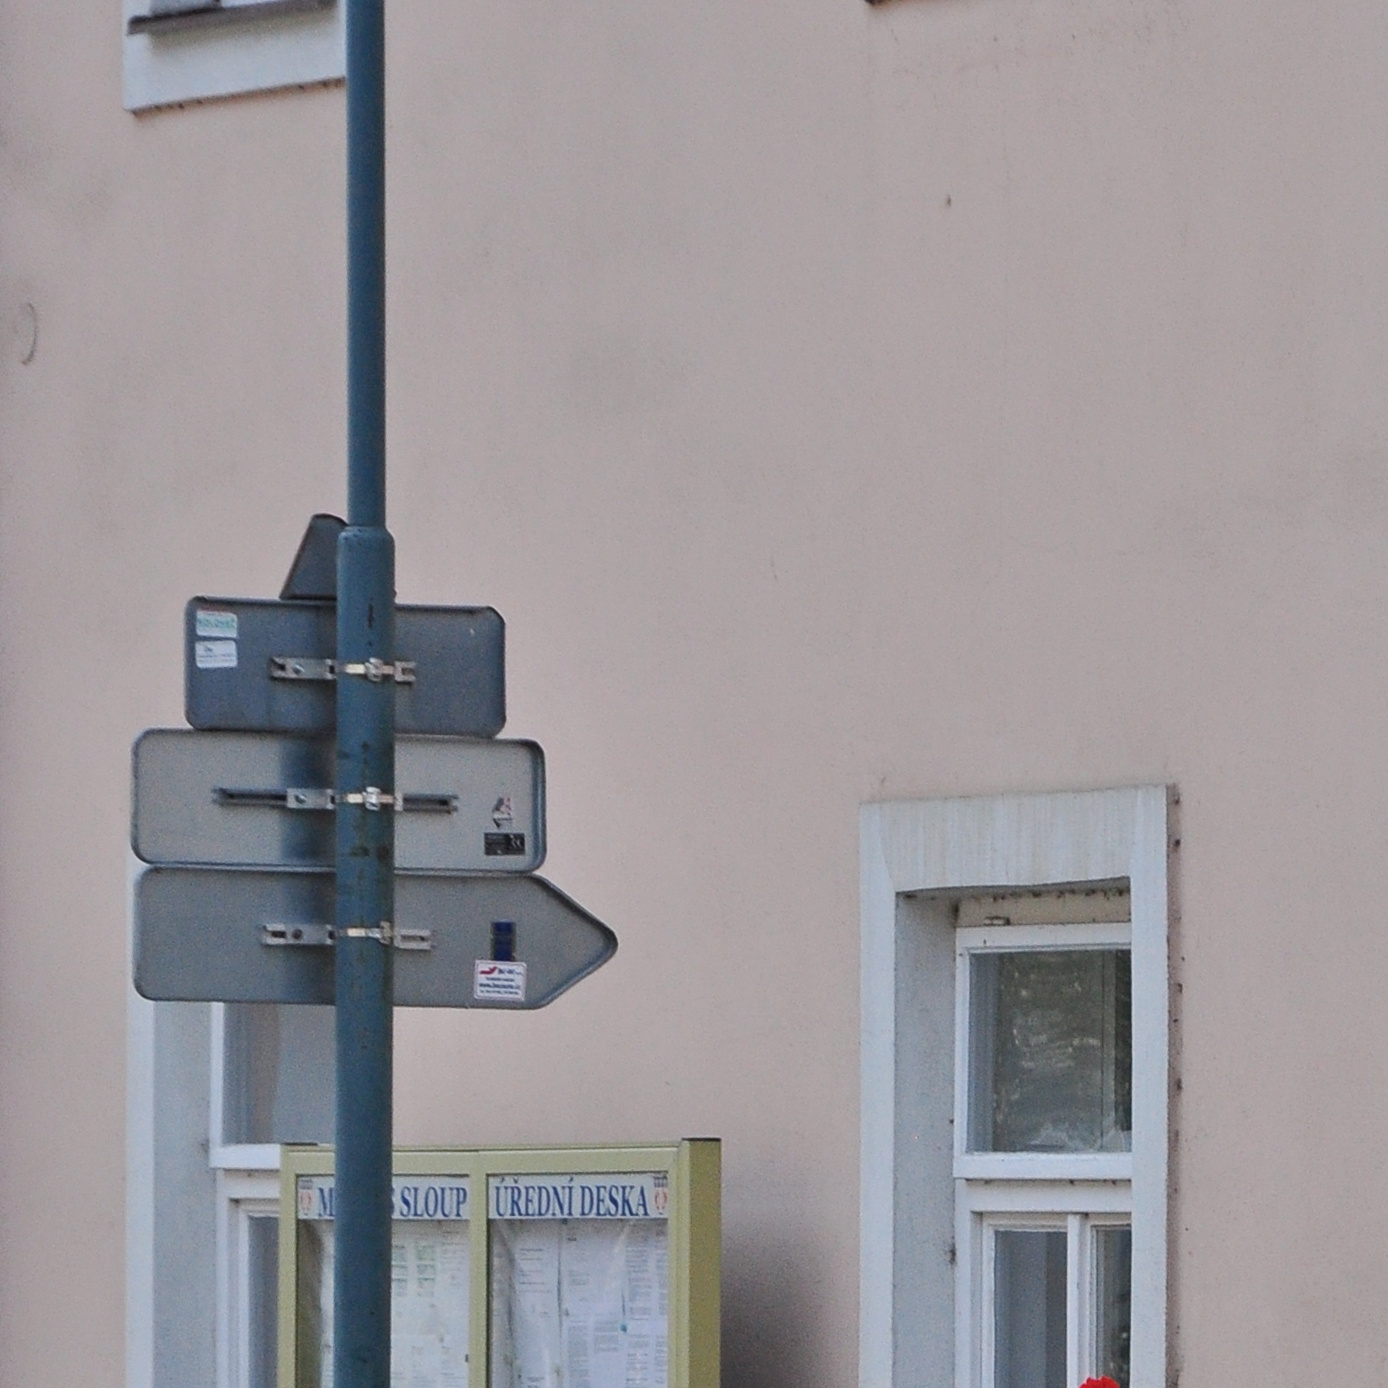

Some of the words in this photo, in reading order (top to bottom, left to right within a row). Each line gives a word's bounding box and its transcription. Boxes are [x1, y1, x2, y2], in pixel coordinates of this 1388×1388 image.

[400, 1186, 467, 1218] SLOUP
[495, 1177, 574, 1217] ÚŘEDNÍ
[580, 1185, 649, 1217] DESKA
